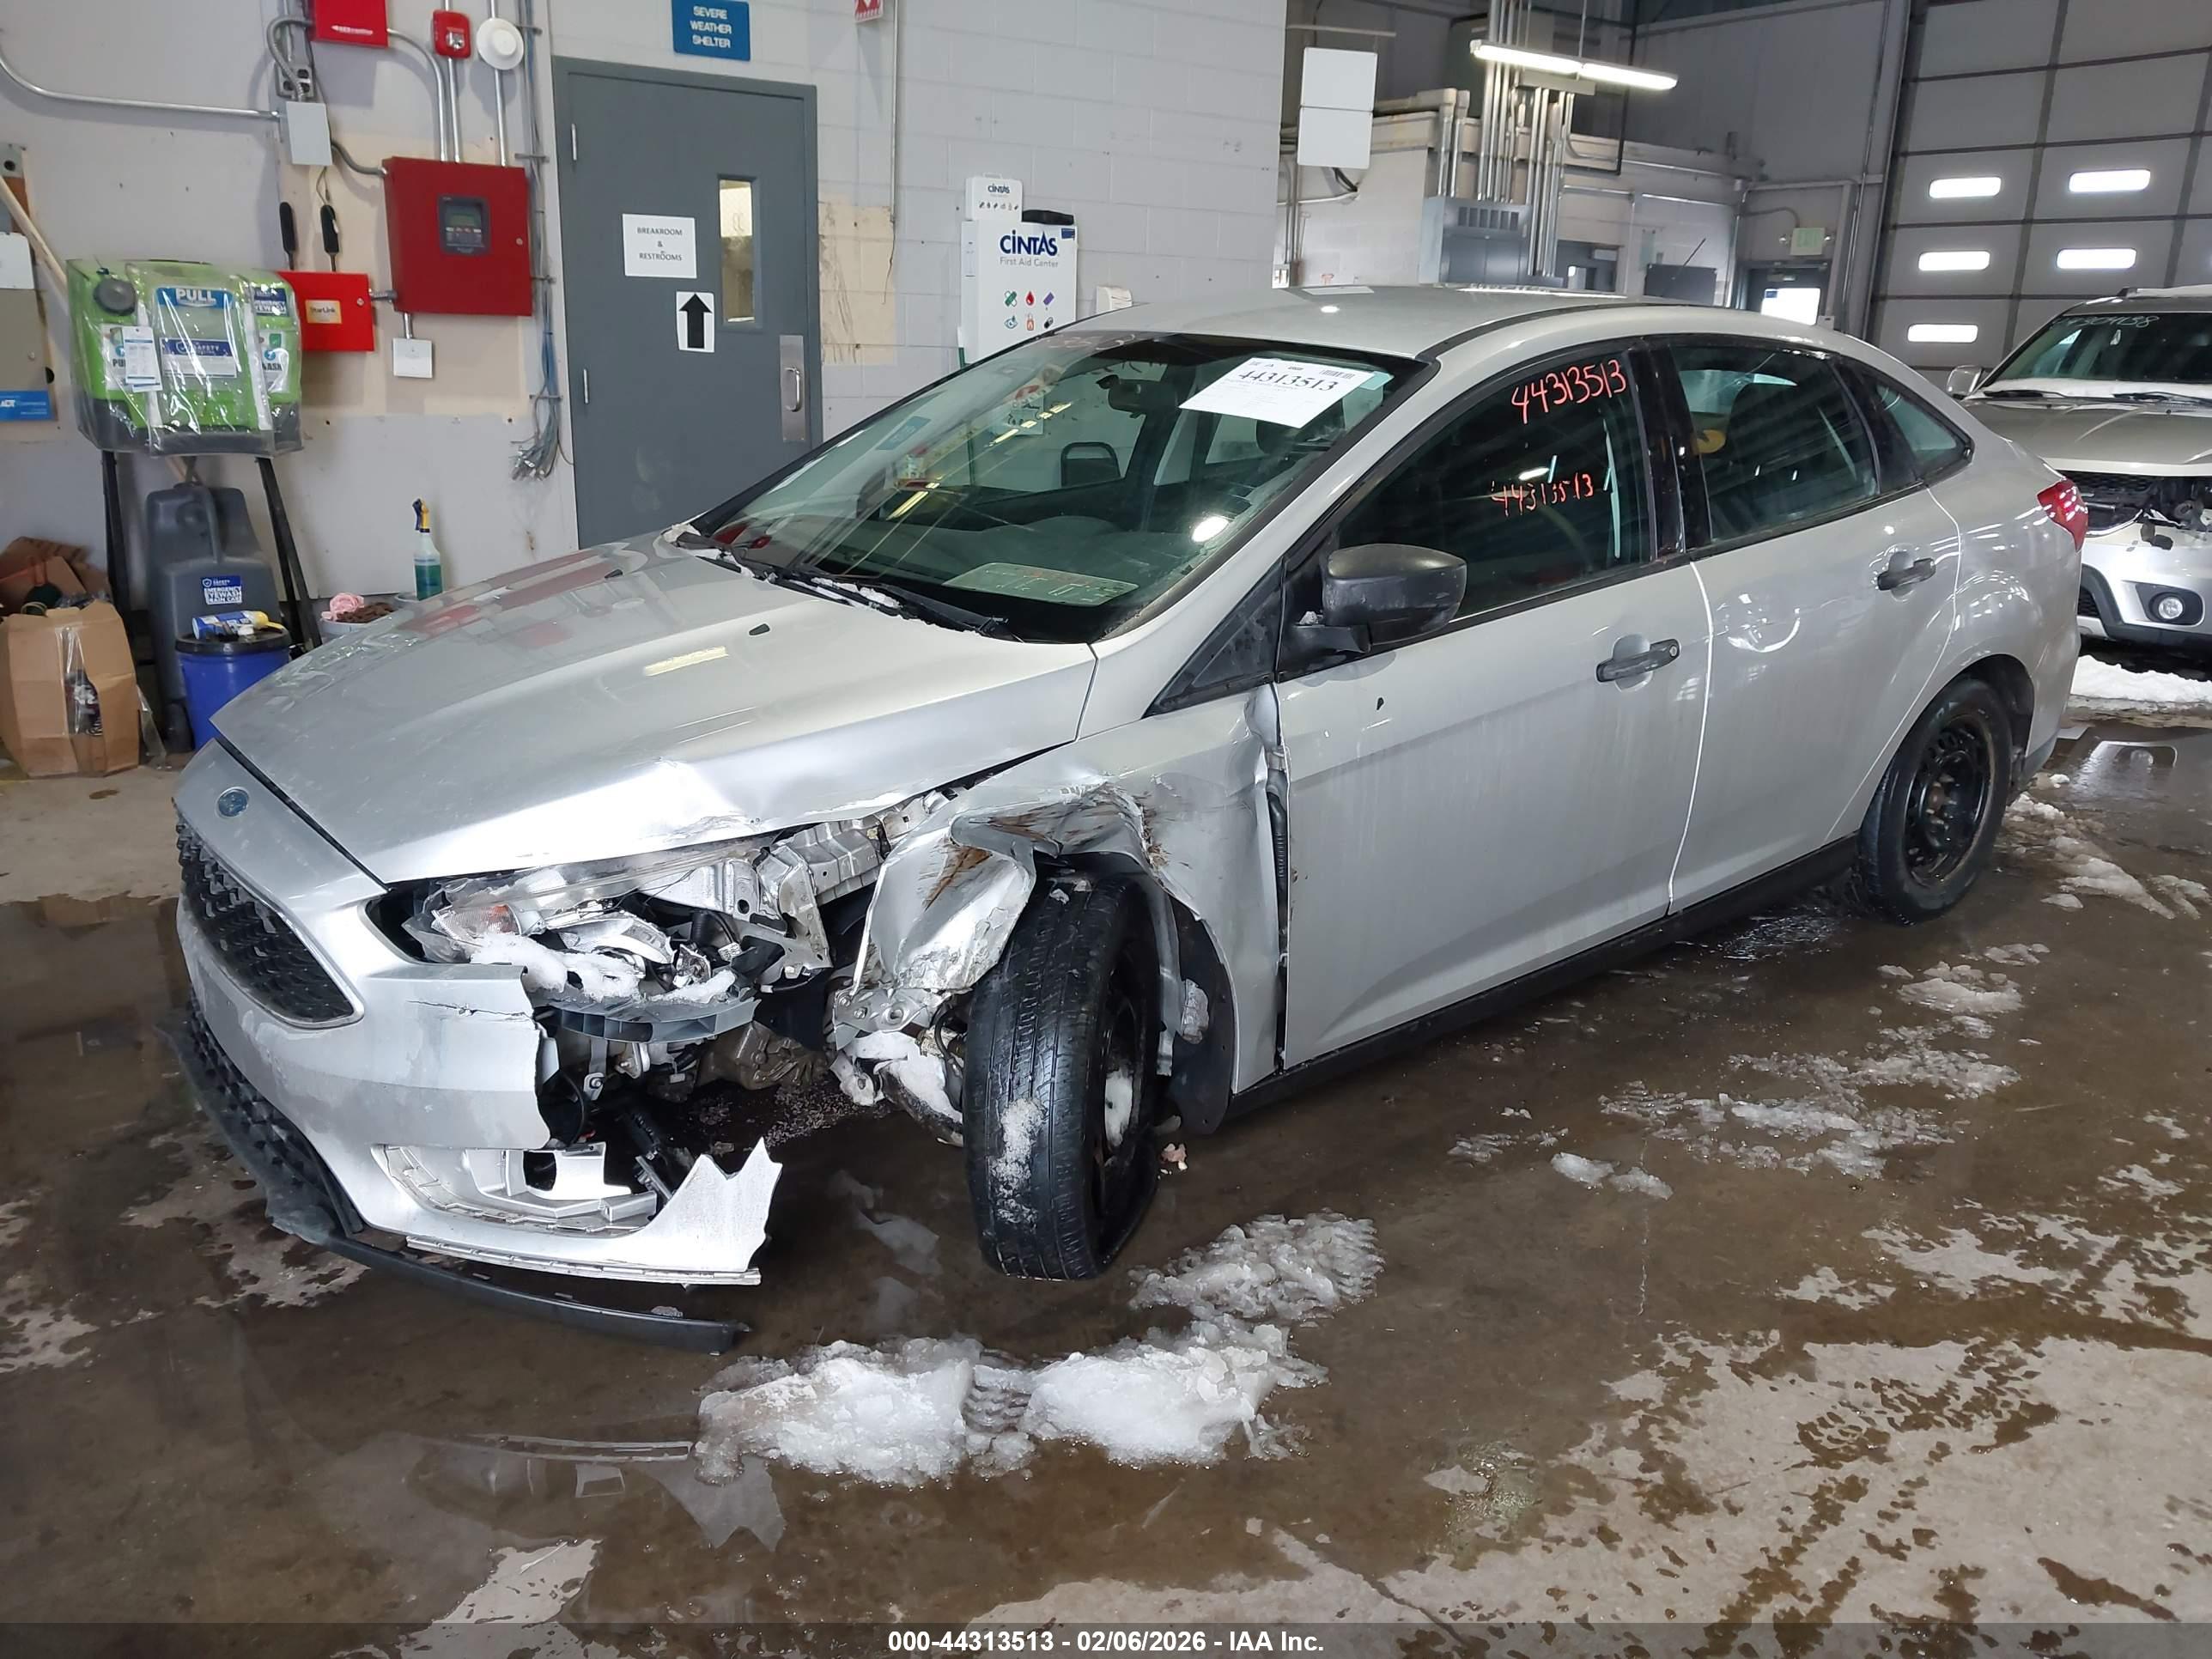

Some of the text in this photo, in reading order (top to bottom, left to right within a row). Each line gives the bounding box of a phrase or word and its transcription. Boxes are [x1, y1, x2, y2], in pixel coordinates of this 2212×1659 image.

[693, 6, 727, 19] SEVERE
[690, 21, 732, 33] WEATHER
[692, 35, 731, 48] SHELTER
[636, 227, 683, 235] BREAKROOM
[639, 252, 683, 261] RESTROOMS
[1000, 257, 1059, 267] First Aid Center
[175, 288, 216, 301] PULL
[1237, 369, 1339, 392] 44313513
[1511, 360, 1626, 424] 44313513
[1492, 473, 1594, 517] 44313513
